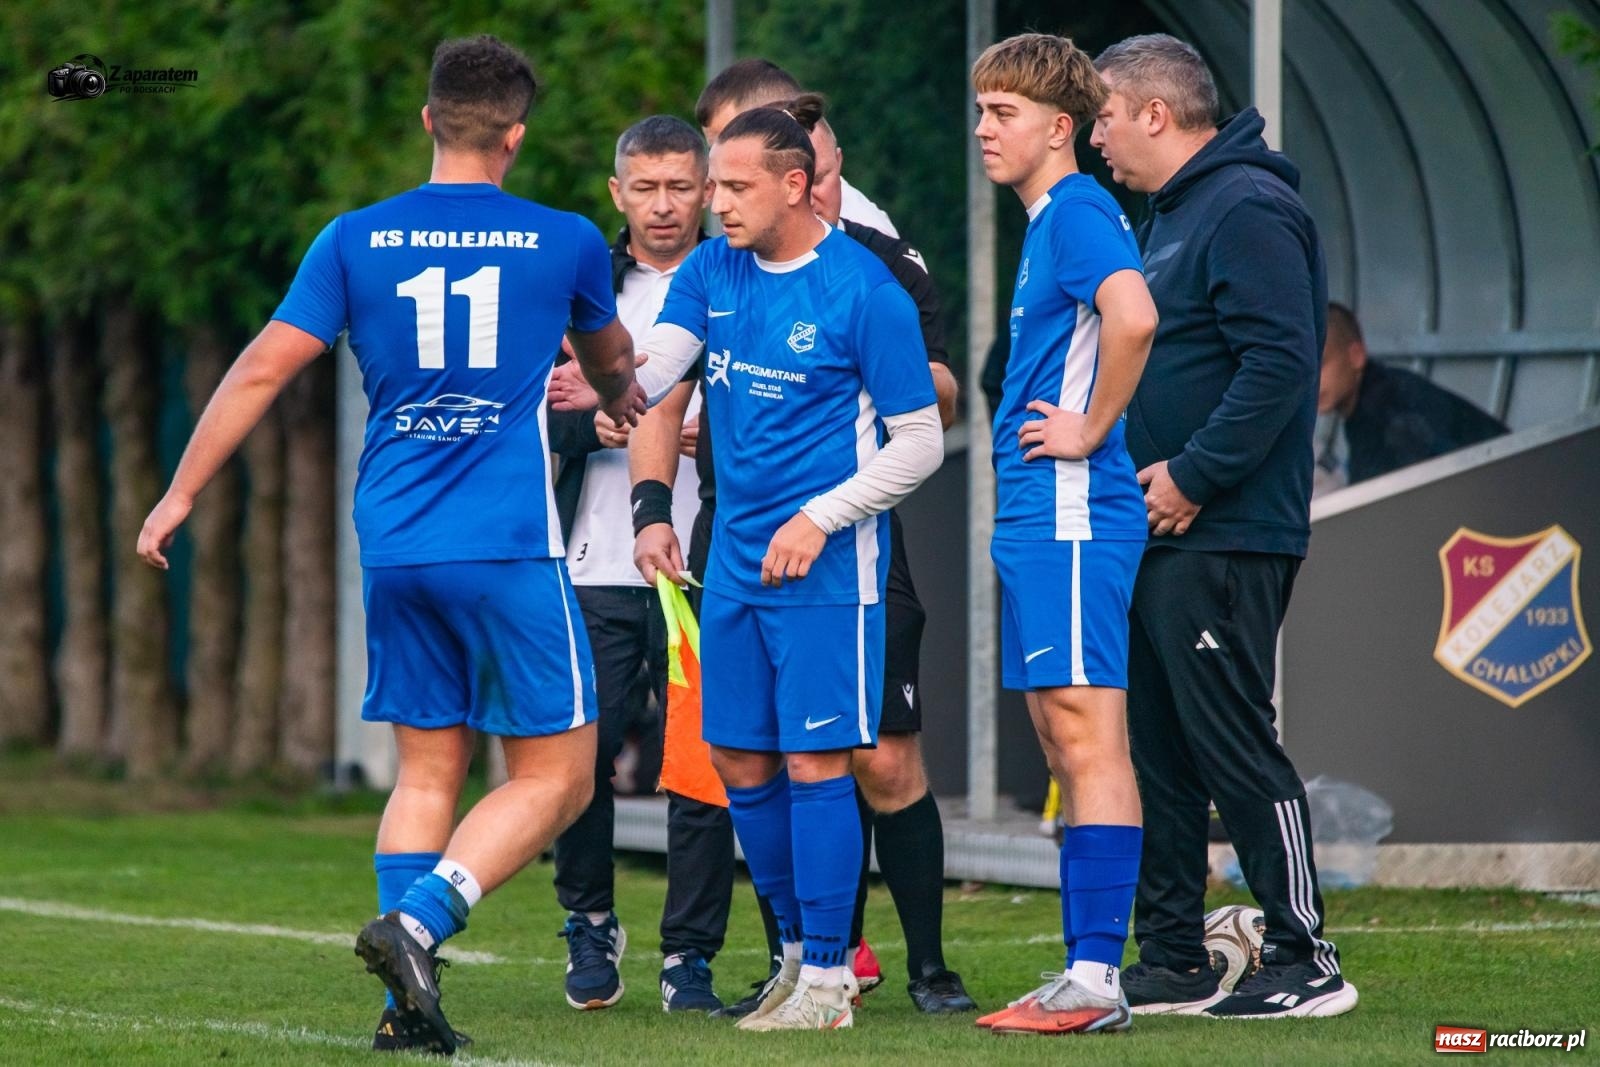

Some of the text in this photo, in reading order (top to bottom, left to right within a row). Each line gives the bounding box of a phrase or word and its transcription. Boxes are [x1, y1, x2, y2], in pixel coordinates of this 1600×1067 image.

[370, 230, 539, 249] KS KOLEJARZ
[396, 266, 500, 369] 11
[1463, 555, 1495, 577] KS
[1450, 540, 1563, 655] KOLEJARZ
[1526, 607, 1569, 626] 1933
